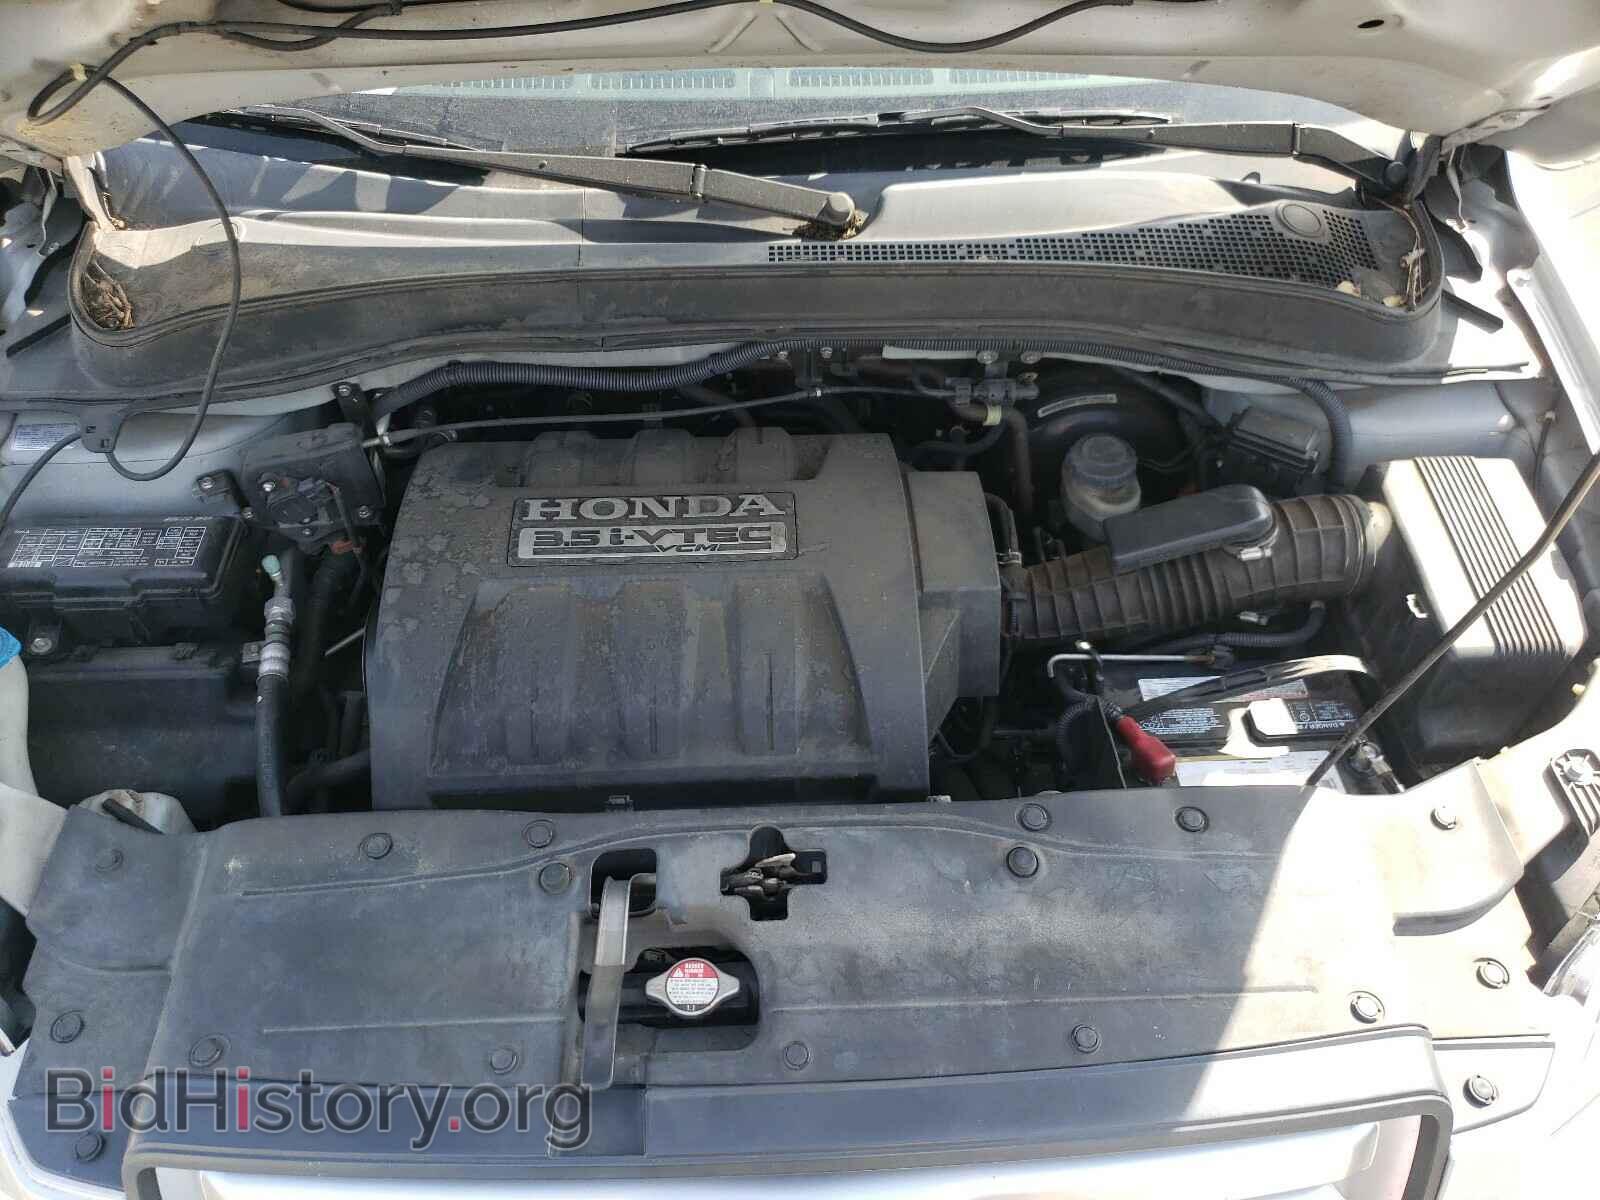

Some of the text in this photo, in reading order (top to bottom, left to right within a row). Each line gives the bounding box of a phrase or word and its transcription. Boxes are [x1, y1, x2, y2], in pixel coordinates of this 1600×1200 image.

[522, 495, 785, 520] HONDA
[533, 528, 771, 545] 3.5 i-VTEC
[657, 544, 718, 552] VCM
